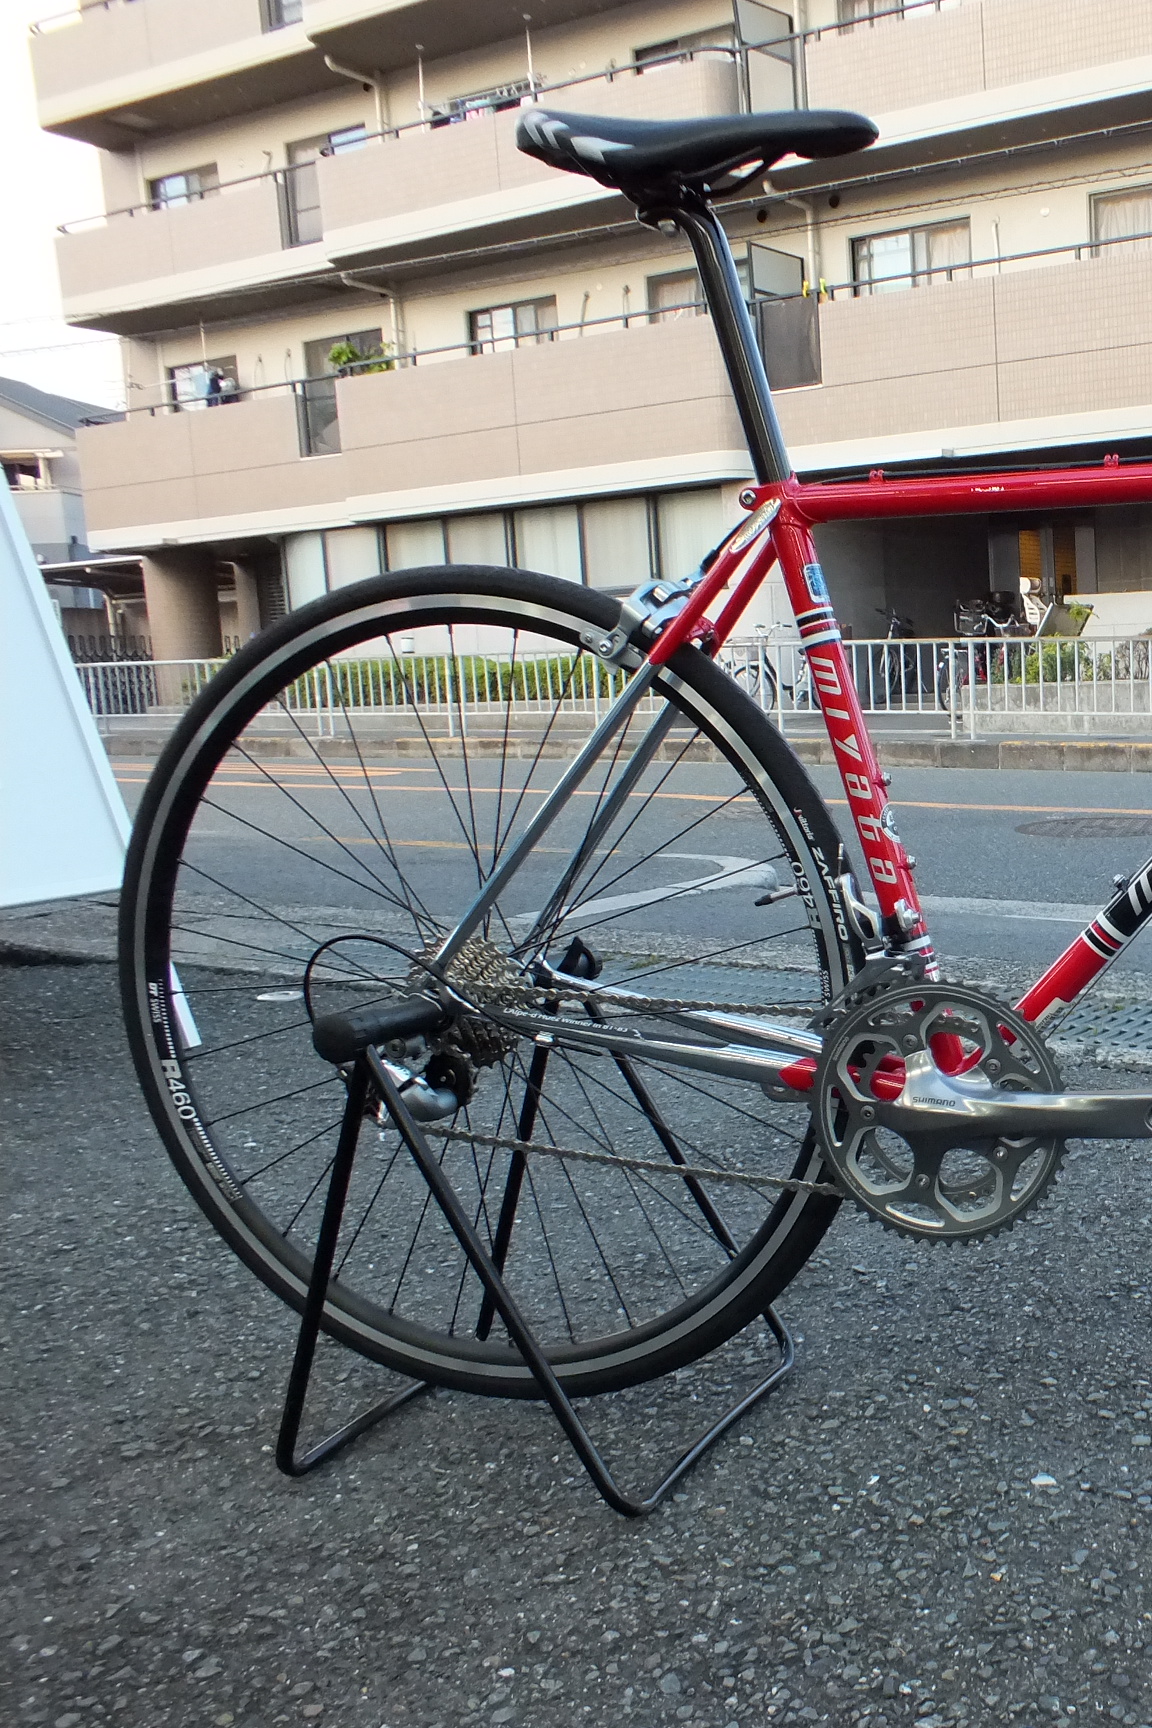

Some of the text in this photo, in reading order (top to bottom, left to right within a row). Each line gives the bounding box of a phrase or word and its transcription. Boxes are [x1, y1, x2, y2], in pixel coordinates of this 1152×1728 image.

[814, 657, 897, 885] miyata
[811, 846, 849, 941] ZAFFIRO
[823, 970, 832, 998] SWISS
[150, 996, 162, 1024] SWISS
[161, 1059, 196, 1121] R460
[911, 1095, 956, 1108] SHIMANO
